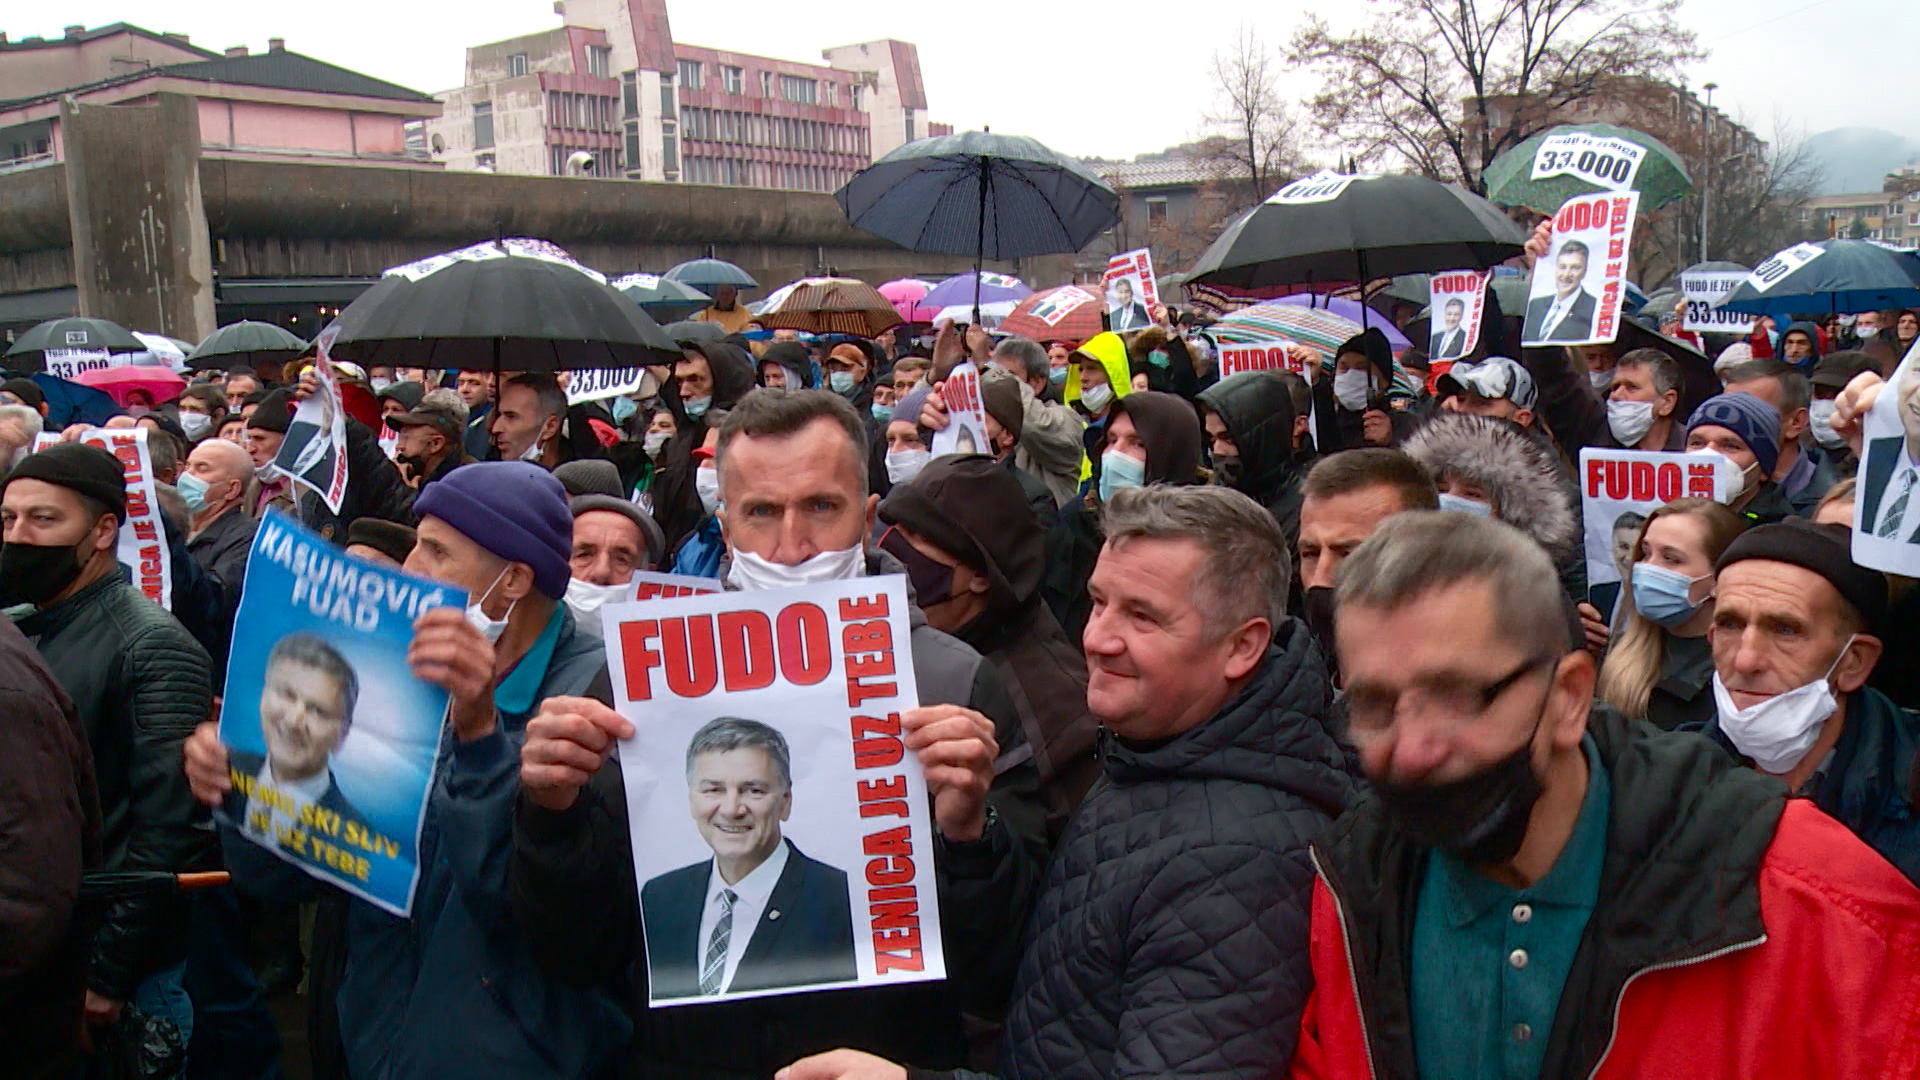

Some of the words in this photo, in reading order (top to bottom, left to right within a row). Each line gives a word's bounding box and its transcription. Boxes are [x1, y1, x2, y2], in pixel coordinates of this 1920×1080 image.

[1540, 150, 1632, 184] 33.000
[1433, 275, 1477, 294] FUDO
[1685, 280, 1707, 292] FUDO
[1588, 459, 1683, 504] FUDO
[291, 574, 380, 633] FUAD
[619, 601, 832, 702] FUDO
[838, 592, 898, 708] TEBE
[850, 711, 905, 770] UZ
[857, 774, 910, 820] JE
[310, 835, 371, 883] TEBE
[343, 819, 401, 860] SLIV
[862, 825, 925, 976] ZENICA
